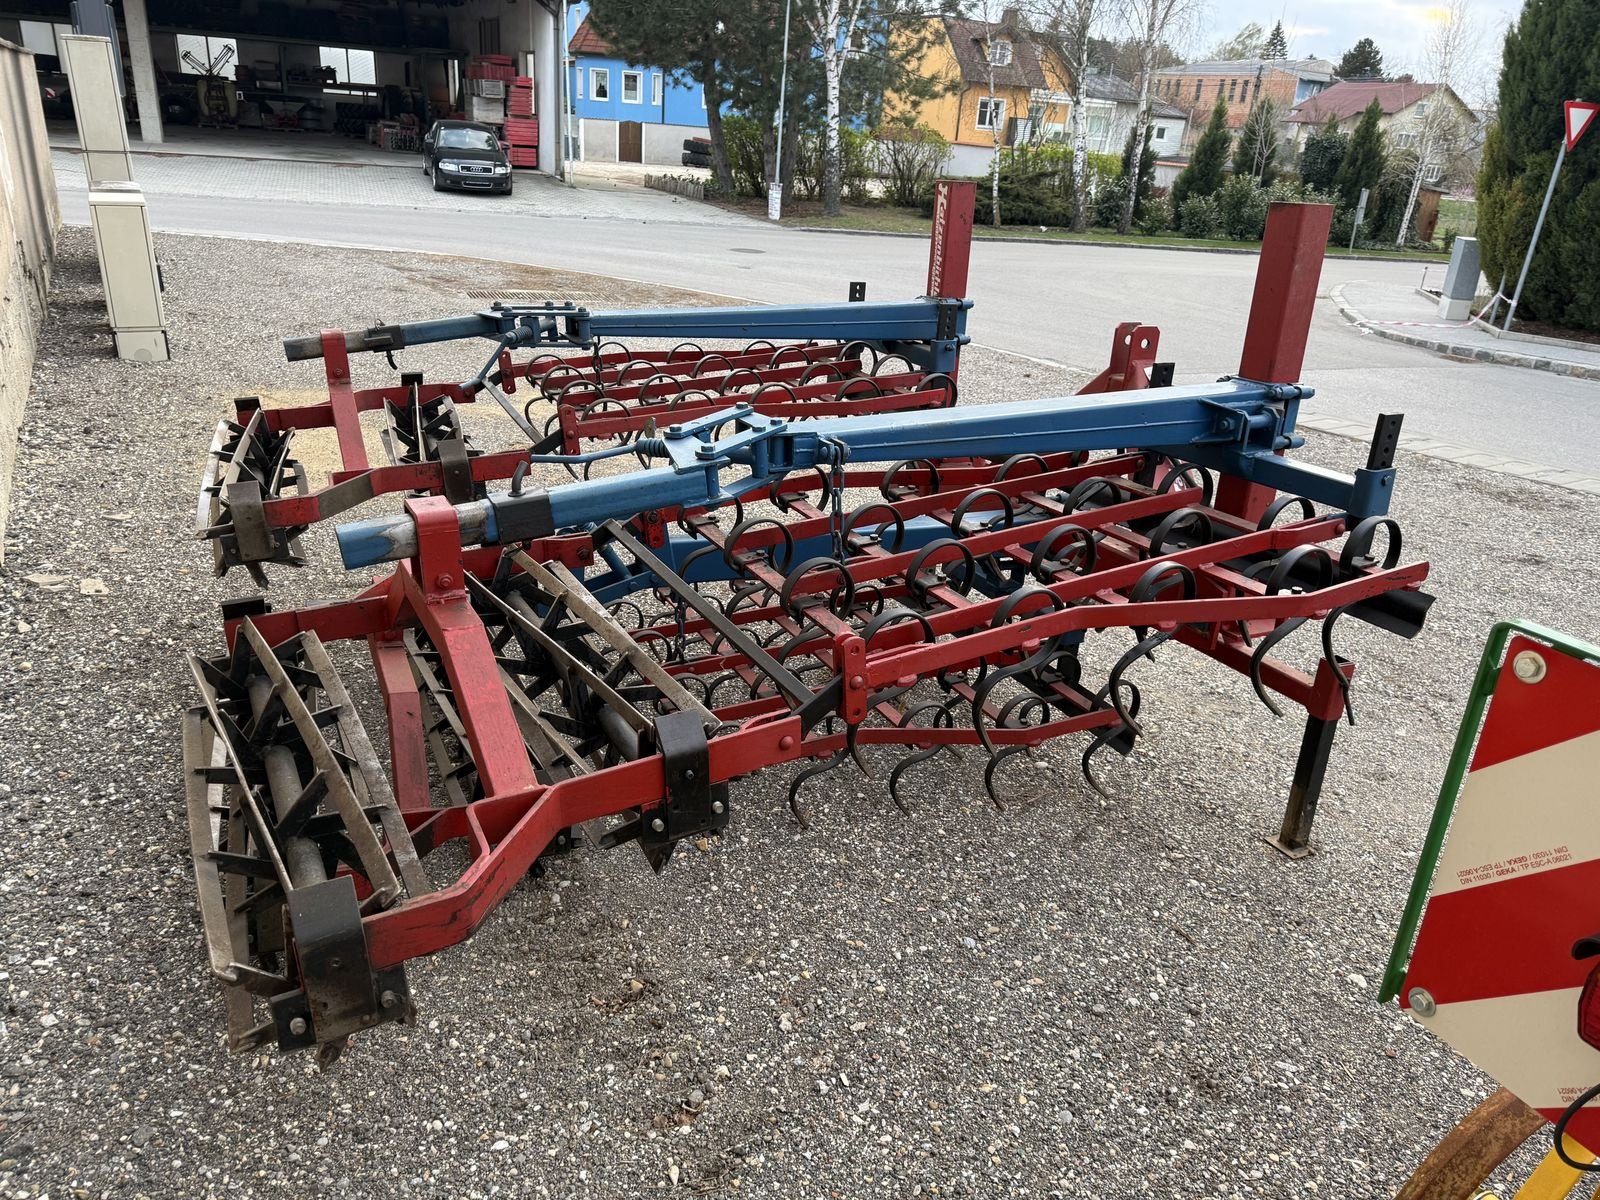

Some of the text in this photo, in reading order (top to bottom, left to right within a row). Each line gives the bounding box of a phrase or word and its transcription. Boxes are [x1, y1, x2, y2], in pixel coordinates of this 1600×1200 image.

[1533, 849, 1552, 859] 11030
[1554, 846, 1568, 854] DIN
[1506, 856, 1528, 866] GEKA
[1473, 873, 1491, 881] 11030
[1496, 867, 1517, 877] GEKA
[1531, 858, 1552, 869] ESC-A
[1474, 864, 1493, 874] ESC-A
